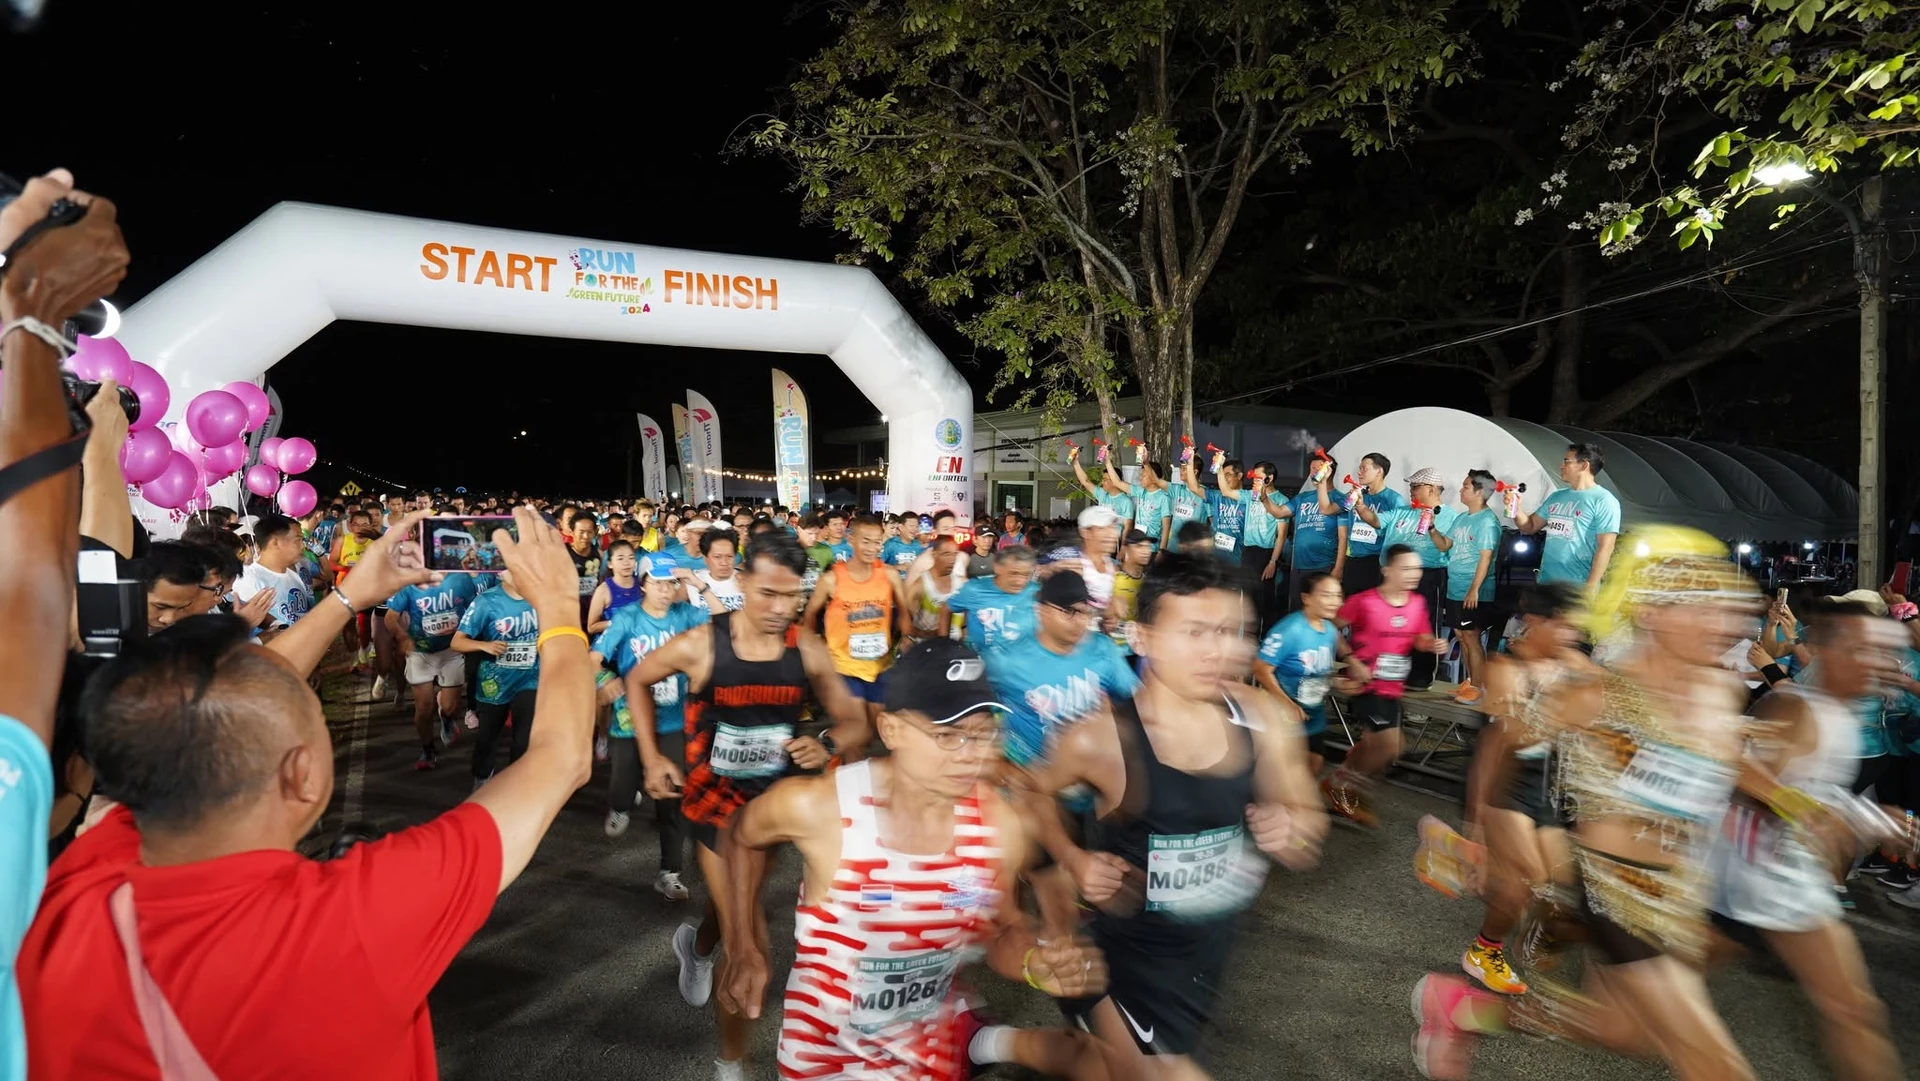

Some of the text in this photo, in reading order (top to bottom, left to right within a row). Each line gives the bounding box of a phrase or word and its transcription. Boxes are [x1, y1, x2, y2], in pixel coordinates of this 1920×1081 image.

[420, 243, 557, 292] START
[579, 248, 635, 274] RUN
[610, 275, 638, 290] THE
[664, 270, 778, 310] FINISH
[574, 290, 640, 303] GREEN FUTURE
[621, 303, 650, 315] 2024
[781, 416, 804, 465] RUN
[936, 456, 963, 474] EN
[419, 589, 453, 615] RUN
[501, 608, 538, 639] RUN
[1154, 839, 1167, 849] RUN
[1169, 839, 1182, 849] FOR
[1184, 839, 1194, 848] THE
[860, 961, 874, 970] RUN
[876, 961, 889, 970] FOR
[892, 961, 904, 970] THE
[906, 958, 928, 968] GREEN
[853, 980, 937, 1010] M0126
